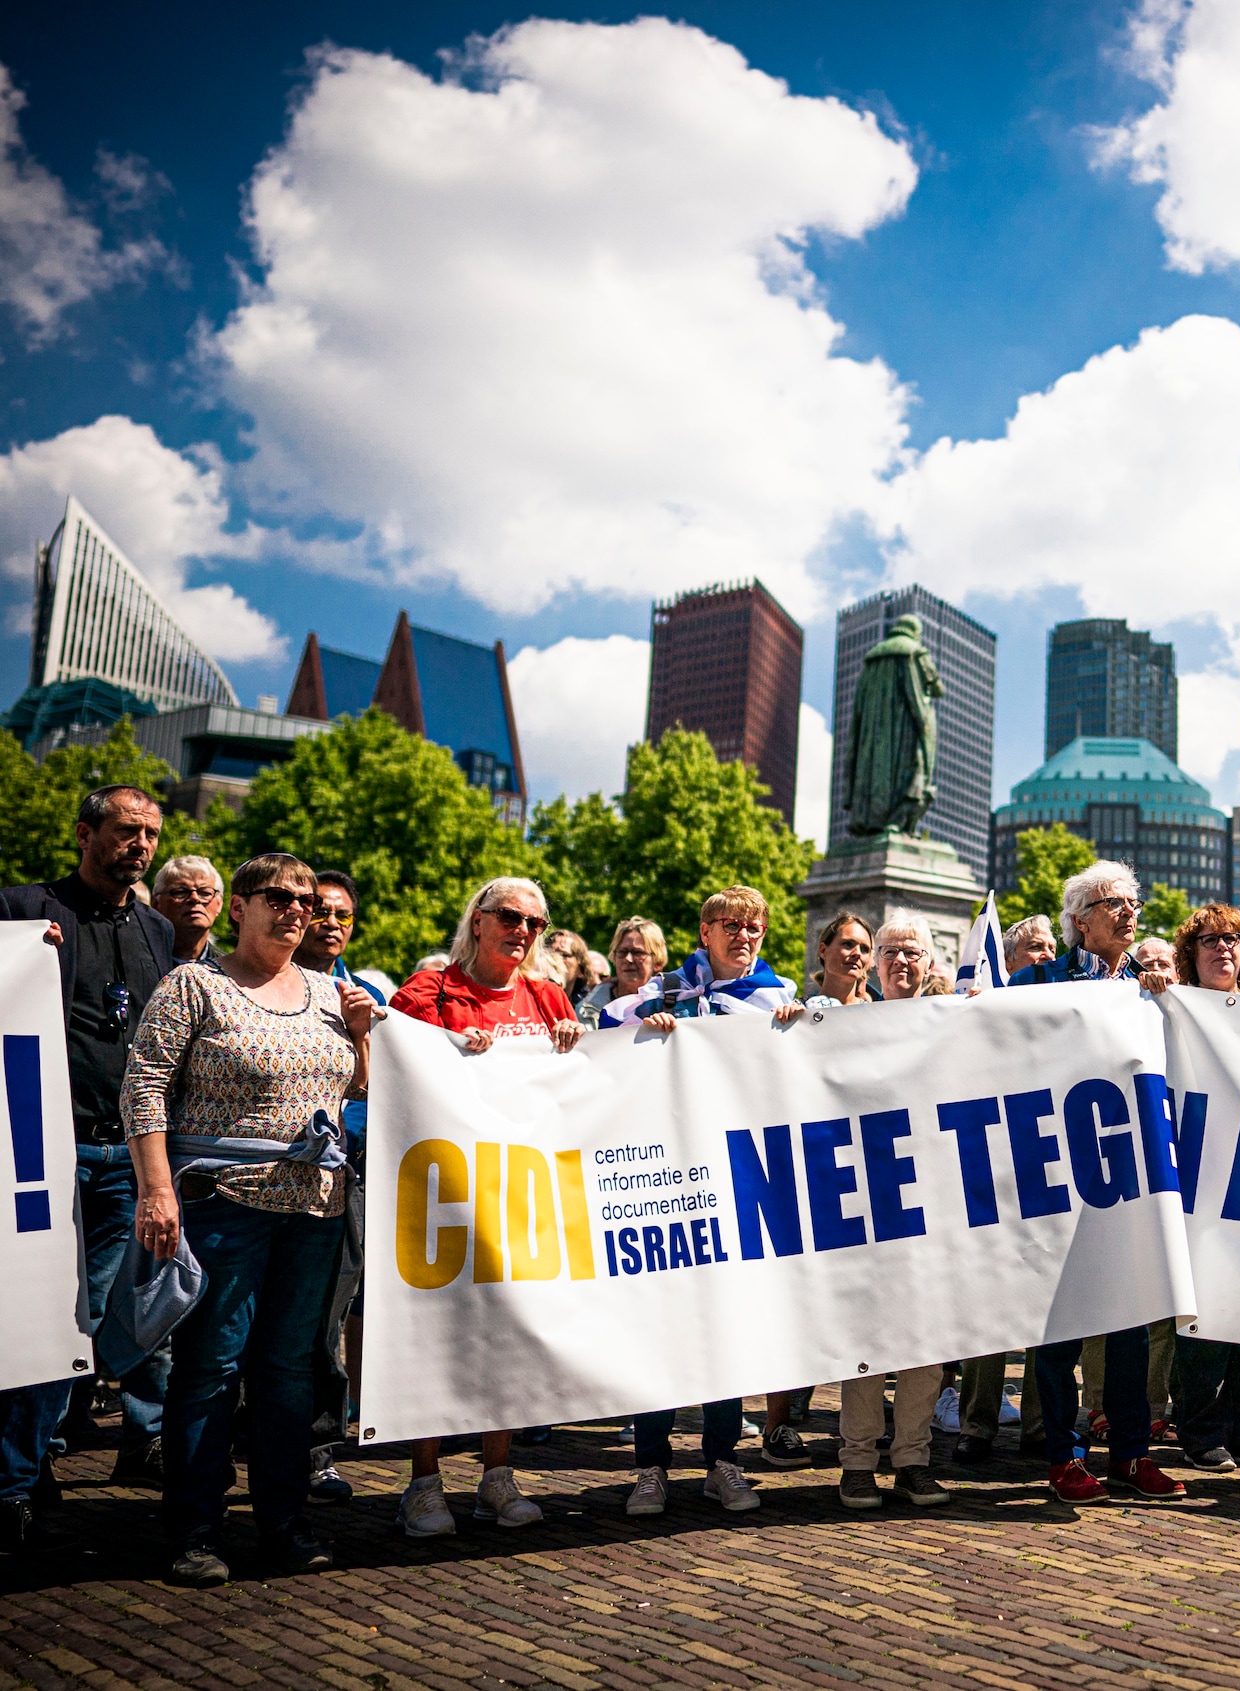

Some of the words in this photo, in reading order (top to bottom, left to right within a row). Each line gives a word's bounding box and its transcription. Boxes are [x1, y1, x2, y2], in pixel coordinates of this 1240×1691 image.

[3, 1035, 51, 1233] !
[595, 1143, 665, 1165] centrum
[597, 1166, 683, 1192] informatie
[688, 1165, 710, 1182] en
[602, 1189, 718, 1220] documentatie
[725, 1108, 927, 1261] NEE
[395, 1138, 596, 1290] CIDI
[604, 1217, 729, 1277] ISRAEL
